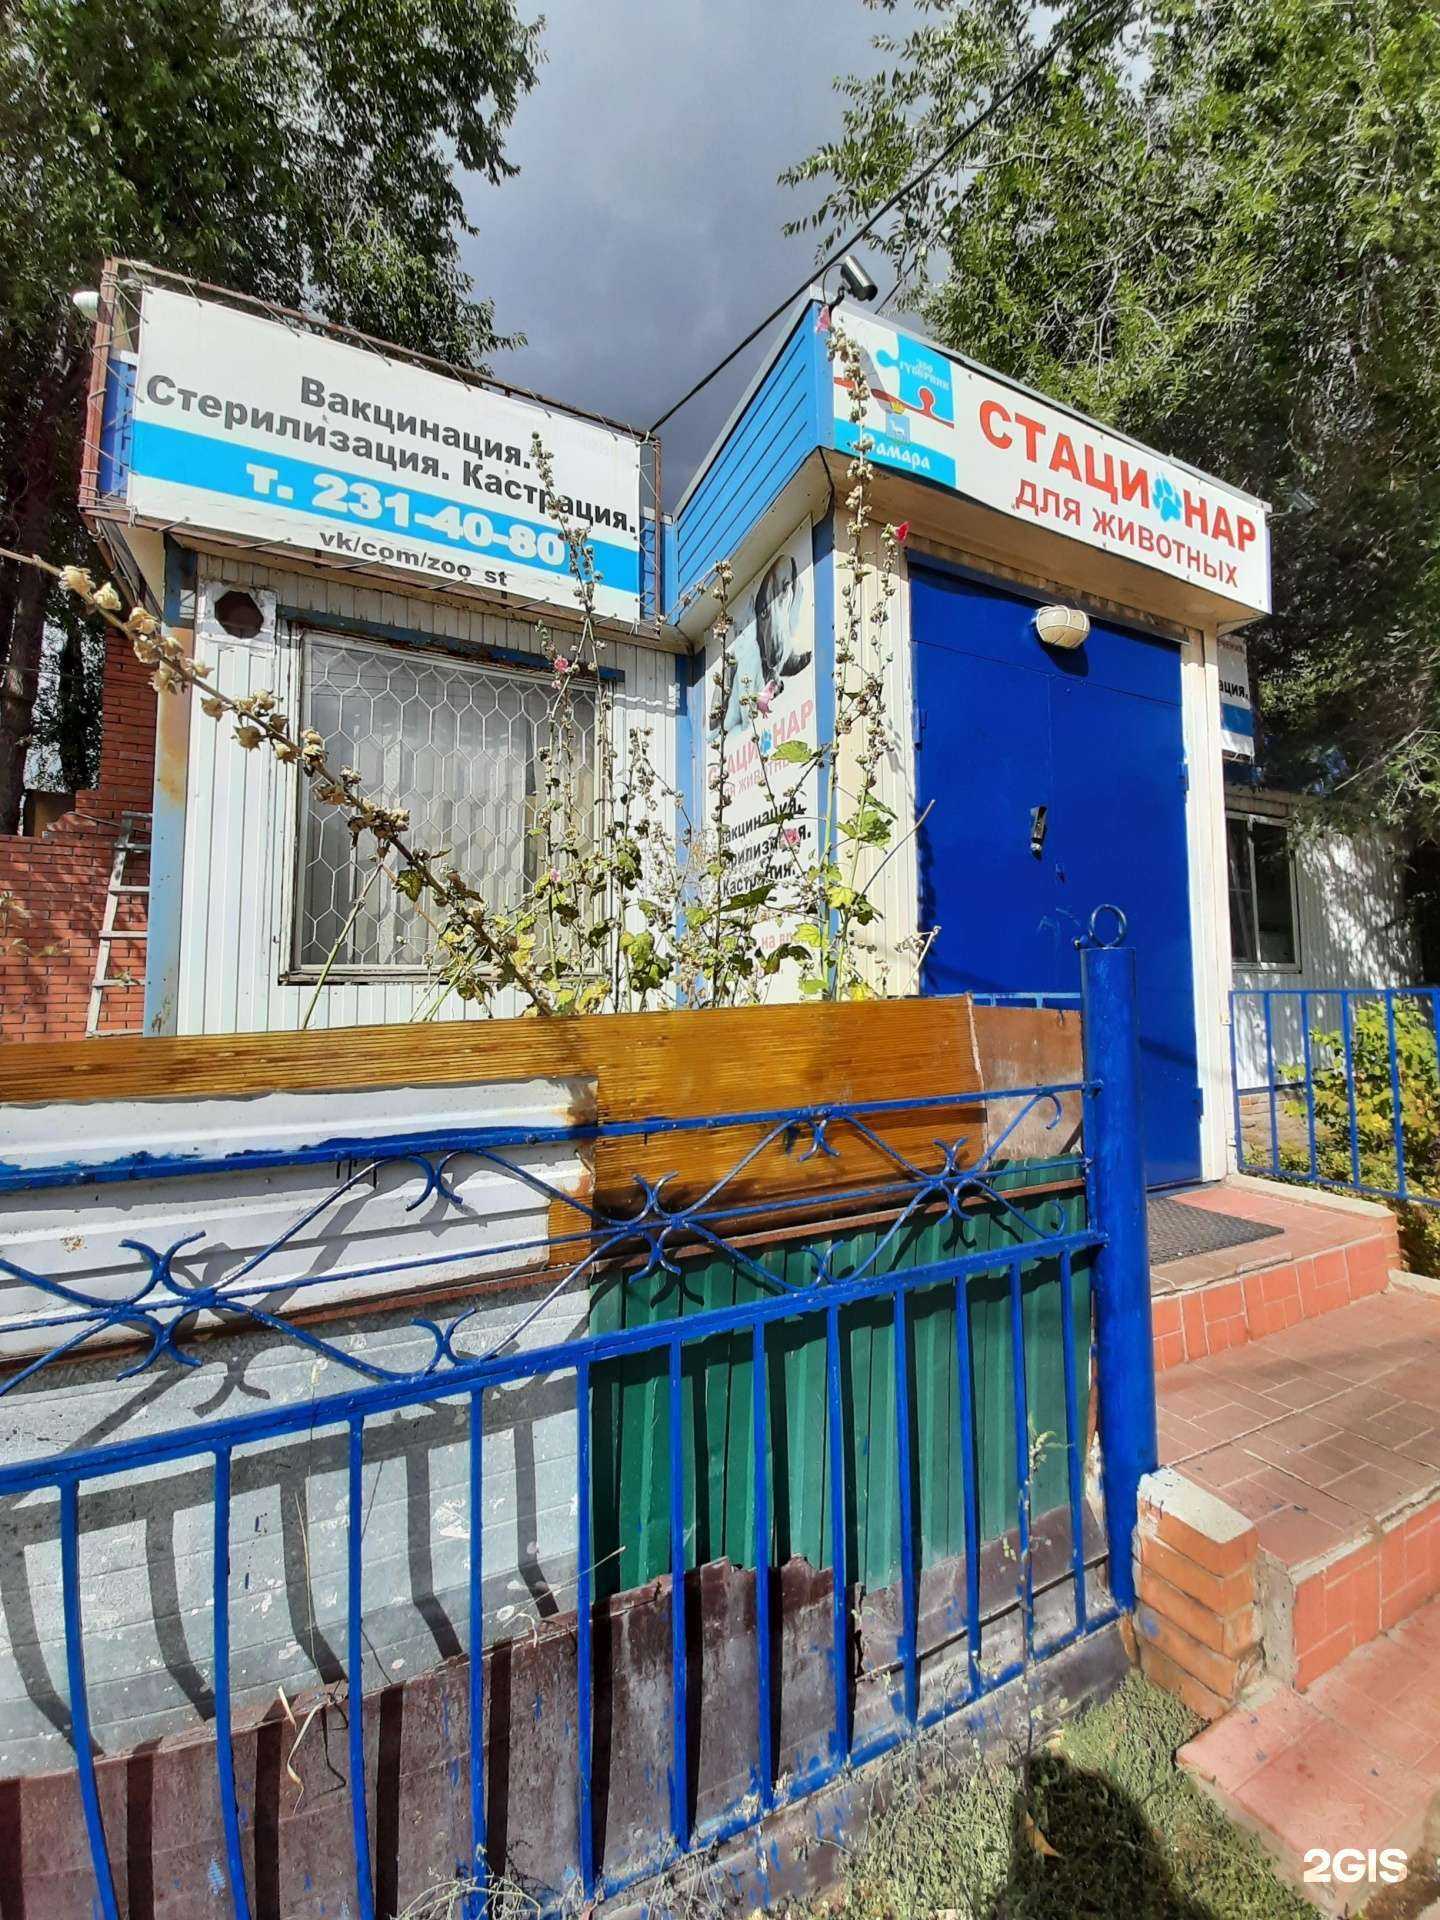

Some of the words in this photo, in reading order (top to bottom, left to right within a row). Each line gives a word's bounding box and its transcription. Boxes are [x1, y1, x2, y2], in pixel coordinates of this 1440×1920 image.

[146, 374, 450, 481] Стерилизация.
[463, 460, 636, 533] Кастрация.
[301, 376, 531, 470] Вакцинация.
[979, 400, 1257, 553] СТАЦИНАР
[312, 473, 566, 565] 231-40-80
